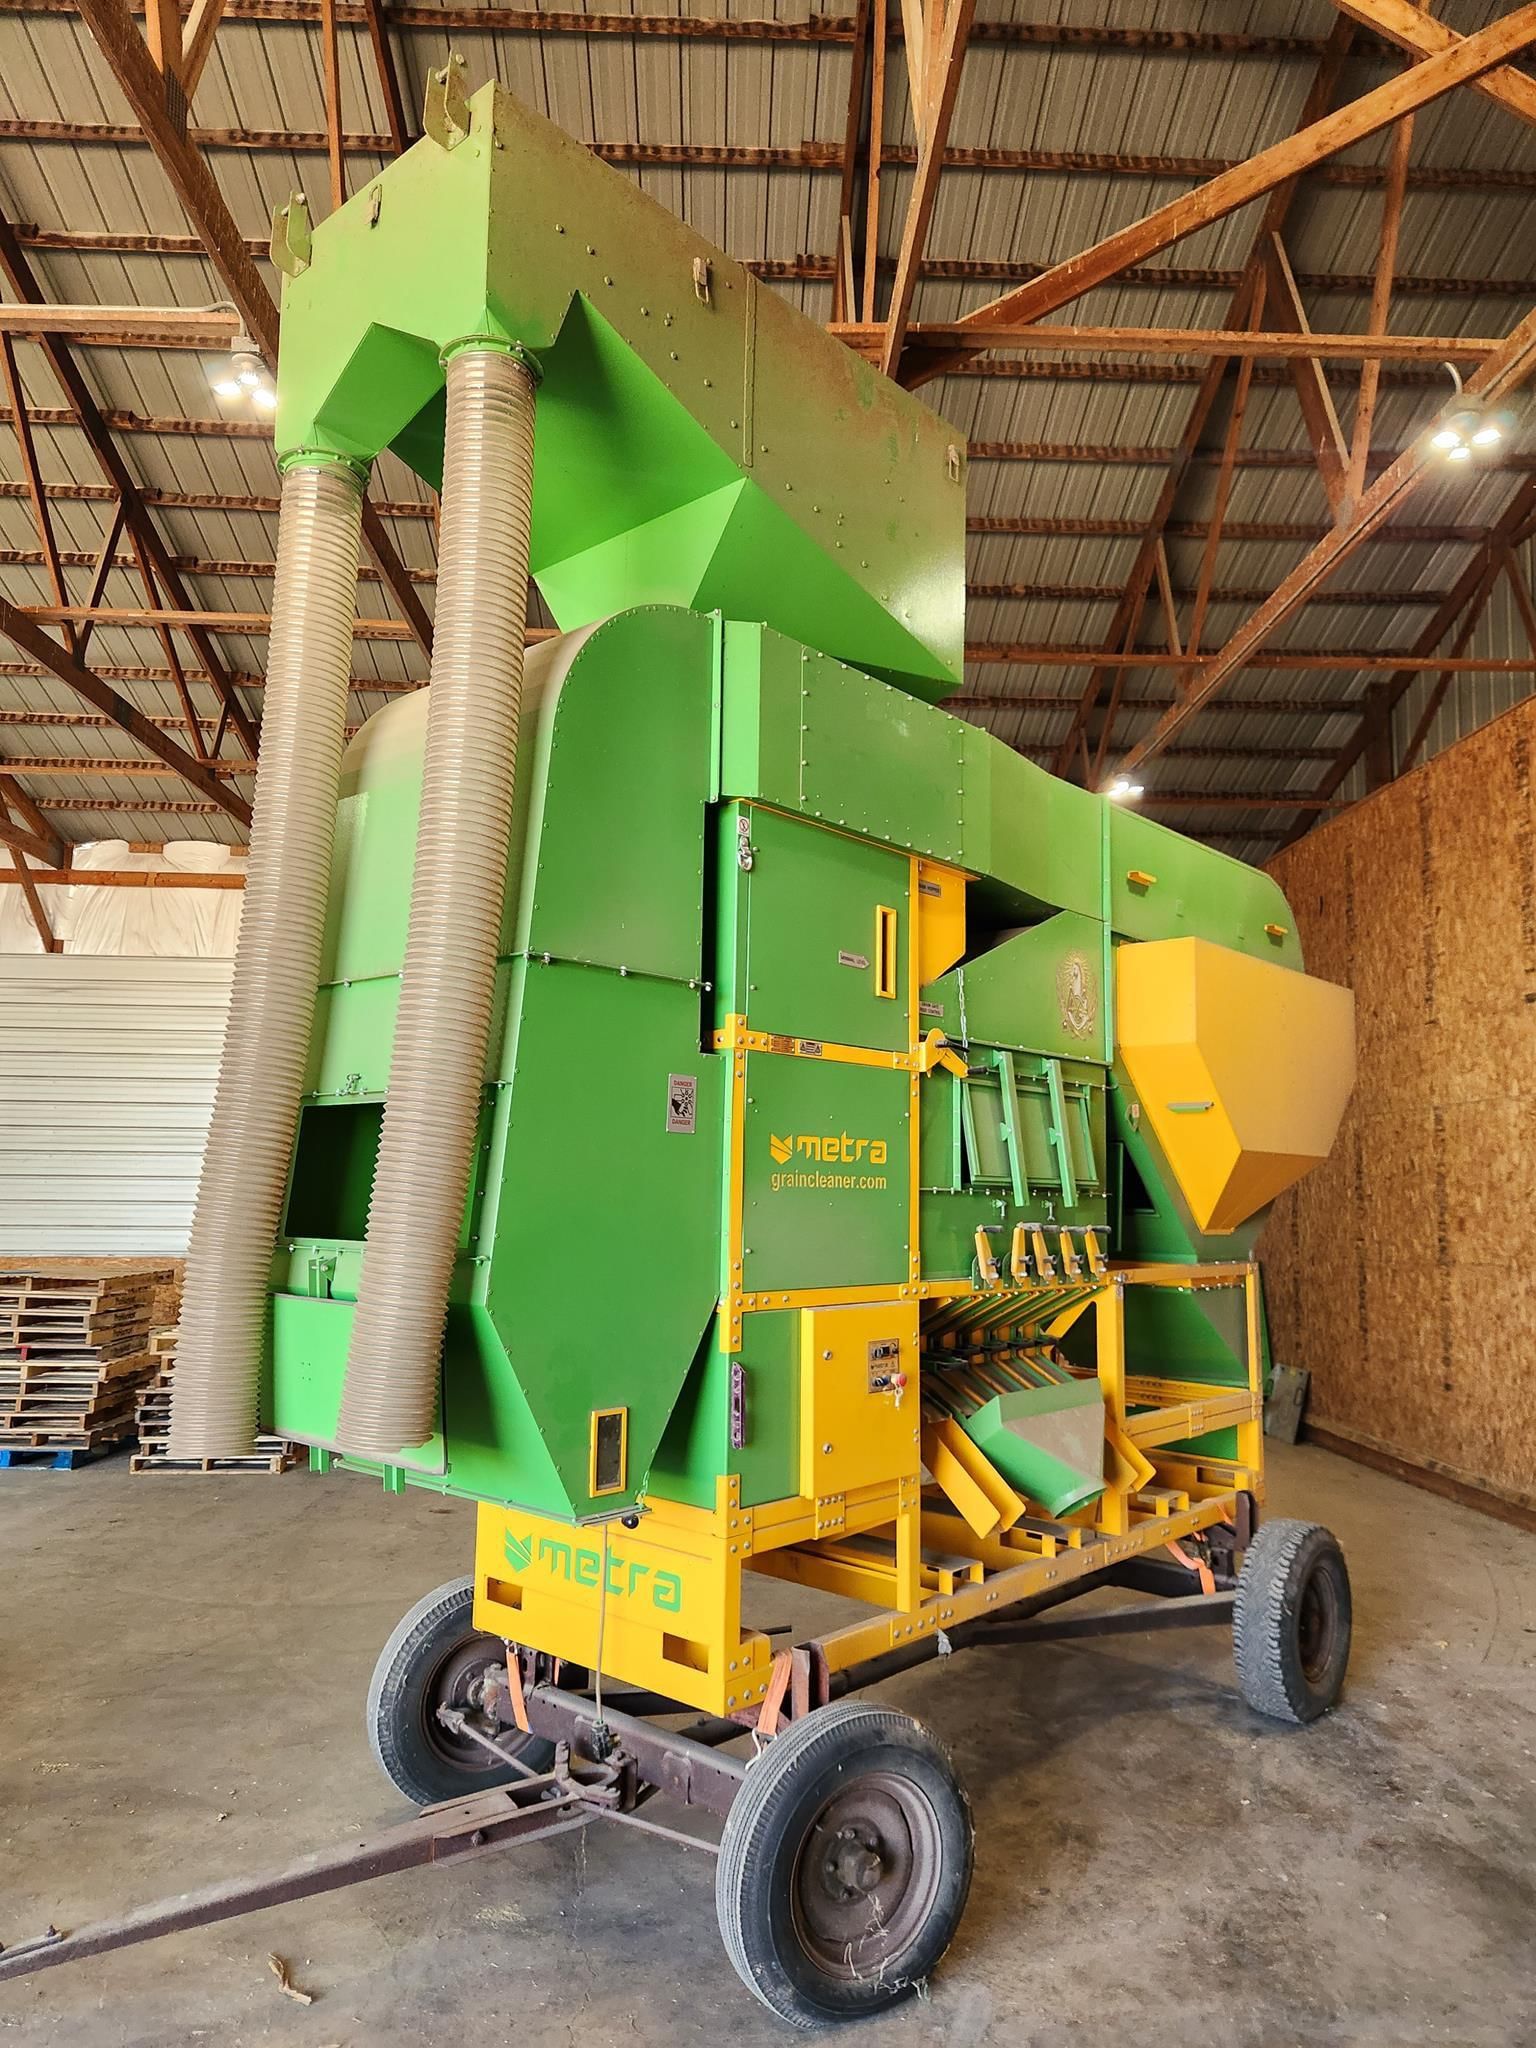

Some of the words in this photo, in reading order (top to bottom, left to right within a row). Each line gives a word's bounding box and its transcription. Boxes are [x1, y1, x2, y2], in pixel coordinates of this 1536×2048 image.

[796, 1130, 887, 1164] metra
[771, 1169, 887, 1192] graincleaner.com
[538, 1537, 682, 1613] metra
